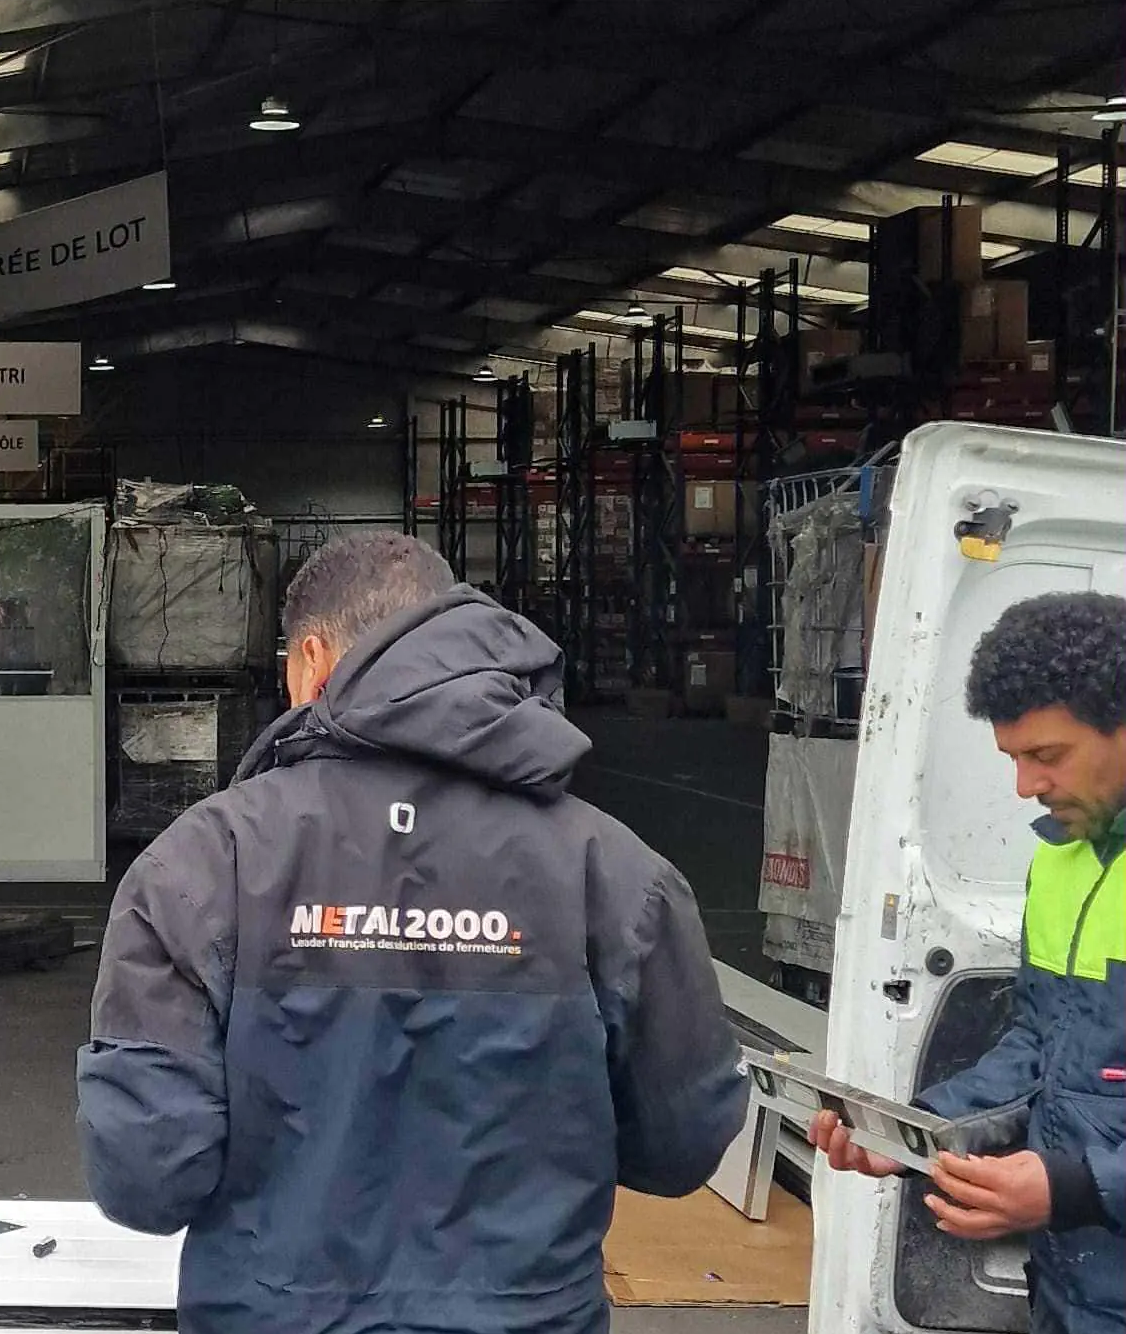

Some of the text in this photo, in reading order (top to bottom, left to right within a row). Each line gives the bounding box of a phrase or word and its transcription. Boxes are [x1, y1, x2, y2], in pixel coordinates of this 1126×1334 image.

[50, 235, 87, 266] DE
[96, 216, 147, 254] LOT
[290, 937, 326, 948] Leader
[328, 937, 376, 951] français
[438, 941, 454, 952] de
[456, 941, 522, 955] fermetures
